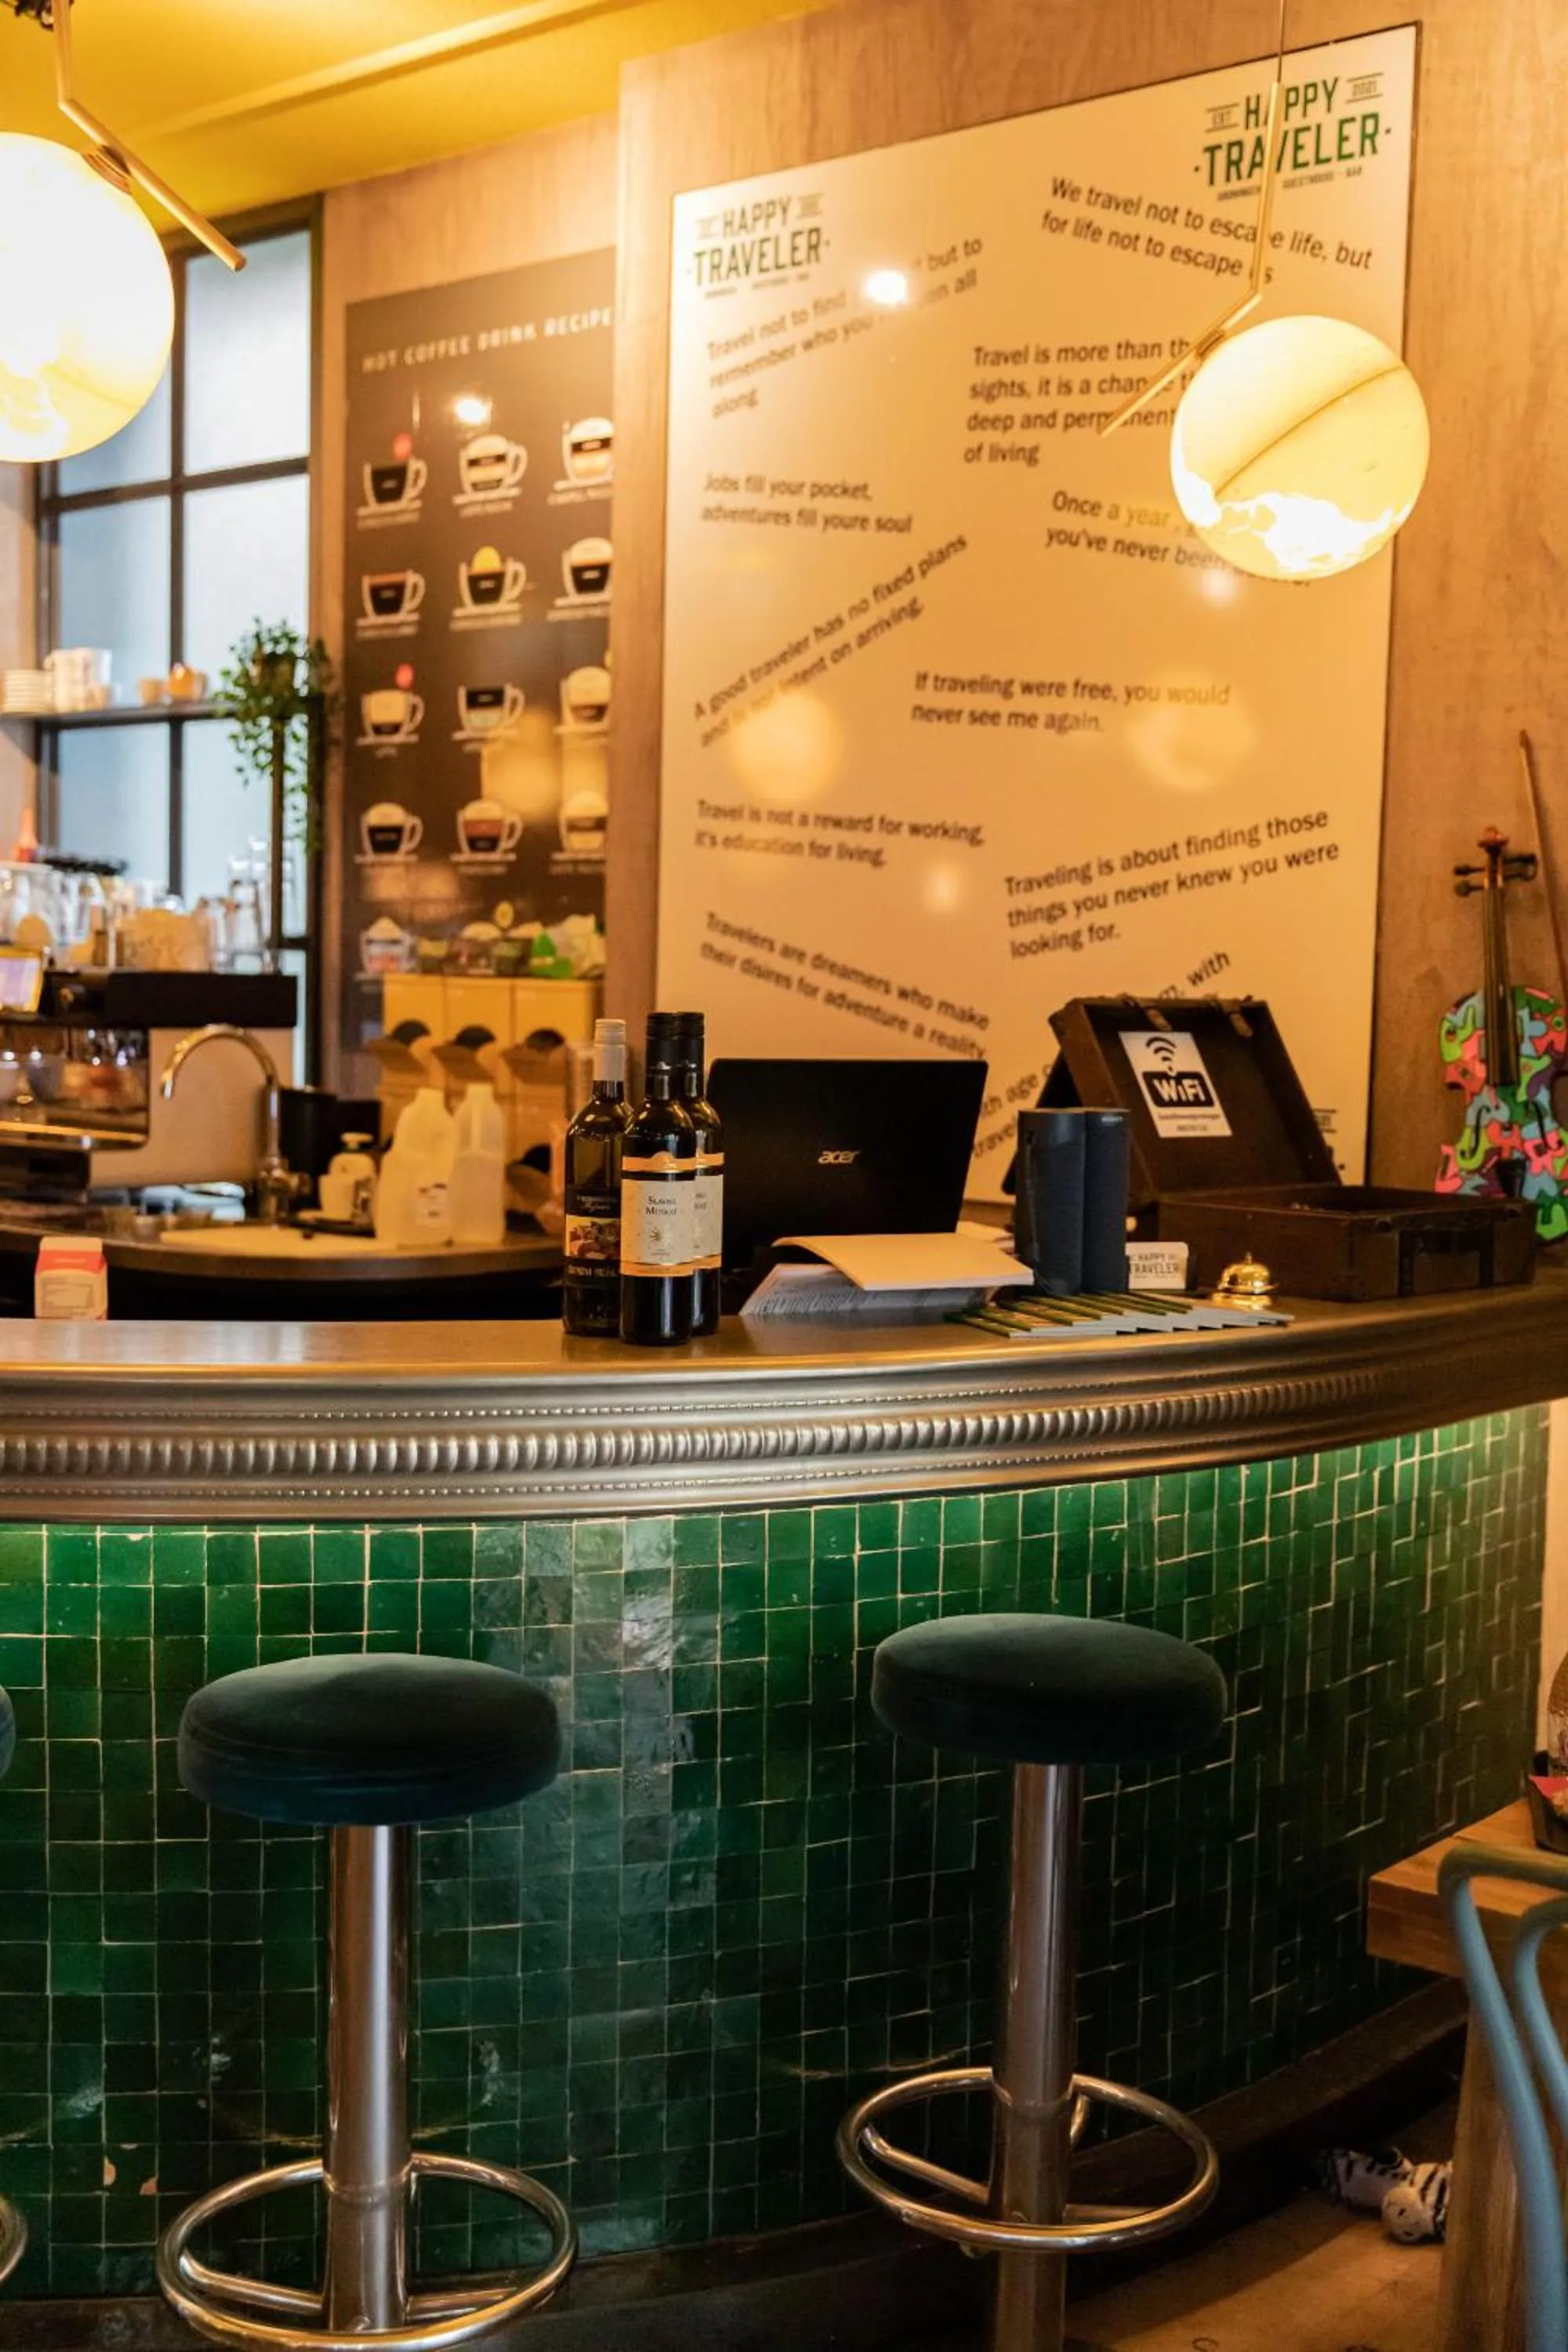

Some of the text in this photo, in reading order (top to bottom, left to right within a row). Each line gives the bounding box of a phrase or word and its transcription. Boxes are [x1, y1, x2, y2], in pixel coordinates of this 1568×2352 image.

[722, 195, 791, 239] HAPPY
[1051, 176, 1374, 270] We travel not to escae life, but
[694, 227, 822, 287] TRAVELER
[1041, 209, 1068, 234] for
[1072, 214, 1103, 245] life
[1107, 227, 1141, 254] not
[1145, 234, 1166, 259] to
[1170, 244, 1243, 278] escape
[707, 326, 756, 361] Travel
[759, 315, 786, 338] not
[792, 307, 809, 328] to
[927, 244, 958, 272] but
[964, 238, 983, 257] to
[710, 343, 797, 389] remember
[802, 326, 838, 353] who
[954, 267, 978, 295] all
[362, 349, 398, 373] HOT
[404, 335, 470, 367] COFFEE
[477, 323, 538, 352] DRINK
[973, 346, 1029, 368] Travel
[1033, 343, 1051, 365] is
[1055, 344, 1110, 364] more
[1116, 338, 1163, 360] than
[969, 377, 1031, 405] sights,
[1037, 377, 1051, 397] it
[1056, 376, 1073, 397] is
[1078, 379, 1091, 395] a
[1097, 374, 1174, 398] chan
[966, 407, 1176, 435] deep and permnent
[964, 443, 1040, 468] of living
[705, 472, 740, 493] Jobs
[769, 480, 806, 500] your
[702, 503, 792, 527] adventures
[874, 513, 913, 534] soul
[1052, 490, 1171, 528] Once a year
[1044, 527, 1226, 570] you've never been
[694, 535, 967, 720] A good traveler has no fixed plans
[829, 642, 853, 666] on
[914, 670, 1231, 706] If traveling were free, you would
[911, 704, 1105, 735] never see me again.
[697, 799, 745, 822] Travel
[748, 805, 762, 822] is
[766, 808, 794, 827] not
[797, 812, 809, 827] a
[813, 812, 875, 834] reward
[878, 815, 904, 836] for
[721, 831, 804, 857] education
[808, 839, 833, 859] for
[1004, 809, 1330, 898] Traveling is about finding those
[1007, 841, 1340, 928] things you never knew you were
[1009, 920, 1122, 960] looking for.
[706, 909, 990, 1032] Travelers are dreamers who make
[1186, 951, 1231, 987] with
[700, 941, 739, 969] their
[796, 975, 822, 1000] for
[823, 989, 910, 1033] adventure
[913, 1022, 926, 1040] a
[928, 1025, 986, 1059] reality
[1006, 1073, 1040, 1104] age
[818, 1149, 862, 1164] acer
